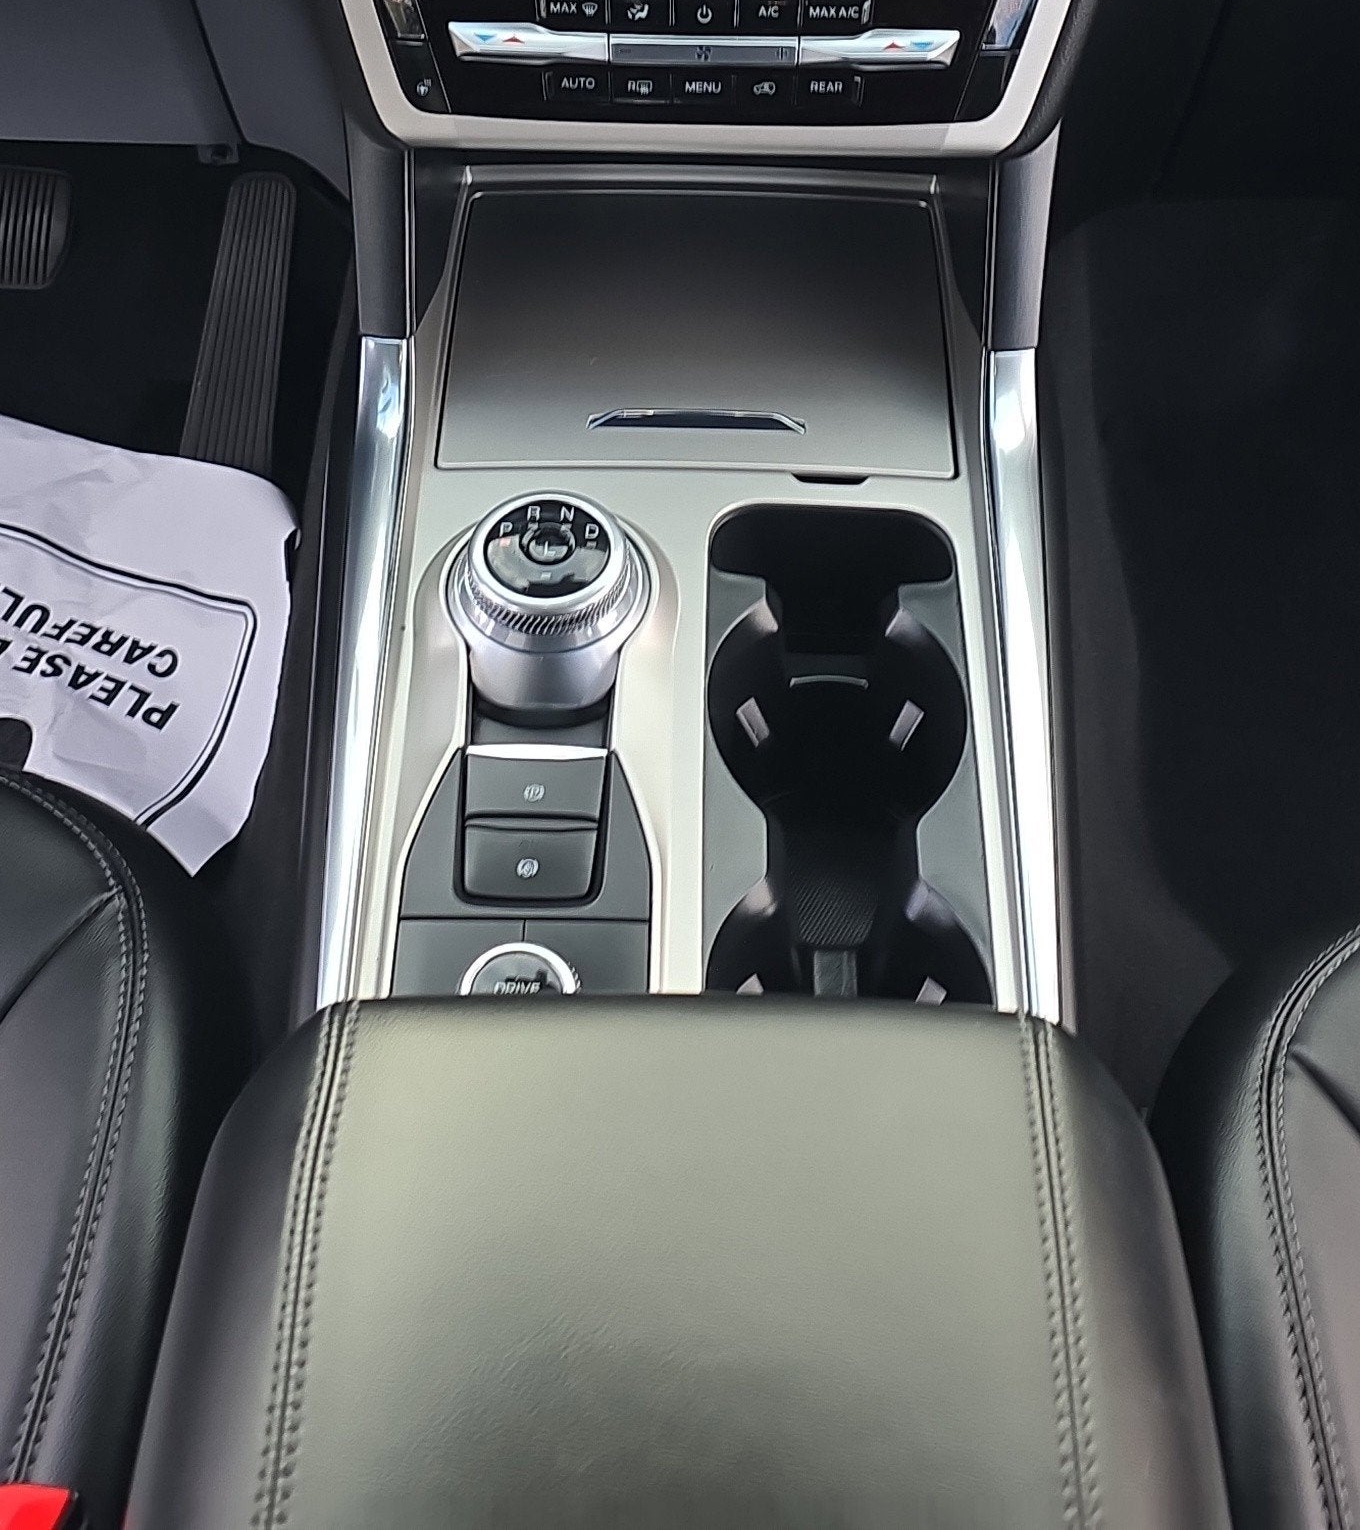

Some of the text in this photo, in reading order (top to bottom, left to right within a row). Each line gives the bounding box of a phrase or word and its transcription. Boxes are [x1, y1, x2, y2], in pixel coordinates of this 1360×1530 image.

[549, 2, 578, 15] MAX
[758, 5, 780, 18] A/C
[808, 5, 860, 19] MAX A/C
[560, 77, 596, 91] AUTO
[684, 80, 722, 94] MENU
[809, 80, 843, 94] REAR
[560, 505, 575, 522] N
[499, 521, 513, 538] P
[584, 523, 600, 540] D
[12, 645, 181, 731] PLEASE
[493, 981, 541, 995] DRIVE
